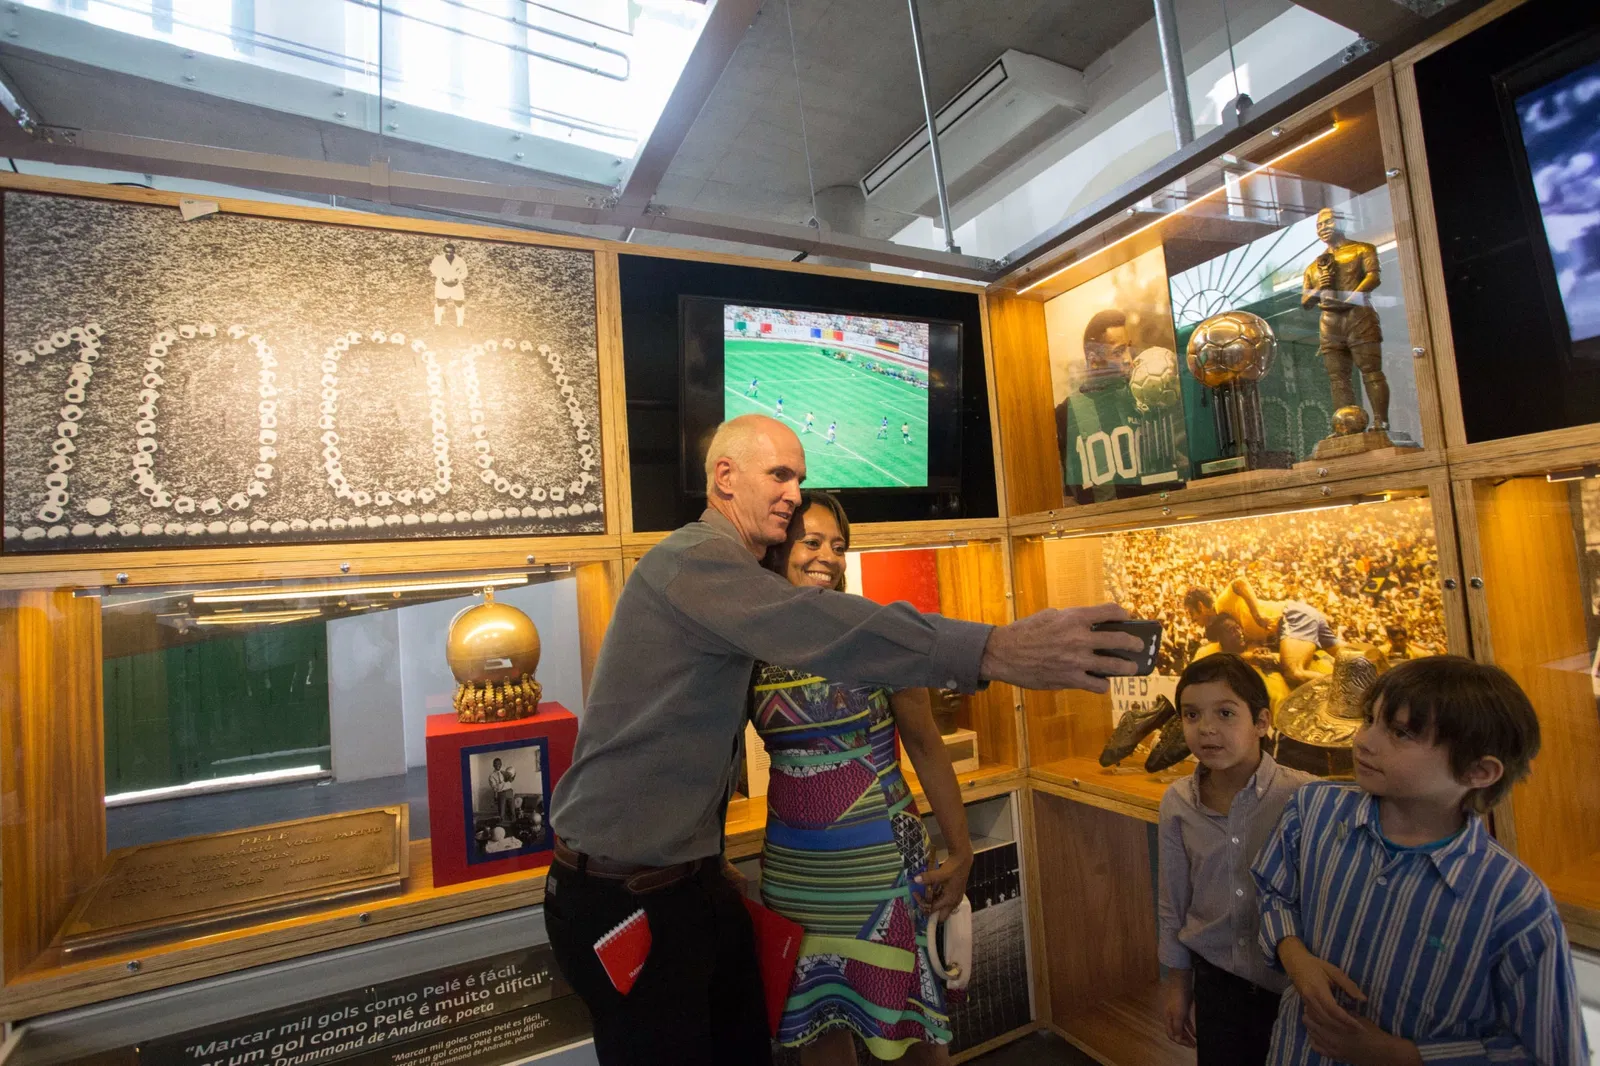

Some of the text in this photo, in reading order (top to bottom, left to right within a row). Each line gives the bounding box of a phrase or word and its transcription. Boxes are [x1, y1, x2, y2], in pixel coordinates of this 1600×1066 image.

[279, 1015, 312, 1036] mil
[318, 1006, 359, 1028] gols
[364, 991, 418, 1013] como
[423, 978, 461, 998] Pelé
[465, 974, 476, 987] é
[479, 964, 522, 986] fácil.
[229, 1048, 265, 1066] um
[271, 1035, 304, 1059] gol
[310, 1020, 368, 1045] como
[374, 1005, 414, 1028] Pelé
[419, 1002, 430, 1016] é
[435, 988, 490, 1012] muito
[274, 1001, 495, 1066] Drummond de Andrade, poeta
[419, 1055, 431, 1065] un
[432, 1049, 447, 1062] gol
[448, 1043, 472, 1056] como
[474, 1035, 492, 1048] Pelé
[493, 1034, 503, 1043] es
[504, 1028, 523, 1040] muy
[429, 1040, 444, 1052] mil
[445, 1036, 468, 1049] goles
[469, 1028, 492, 1041] como
[494, 1020, 512, 1033] Pelé
[512, 1019, 522, 1028] es
[523, 1012, 543, 1026] fácil.
[472, 1048, 482, 1057] de
[482, 1039, 514, 1054] Andrade,
[514, 1032, 534, 1045] poeta
